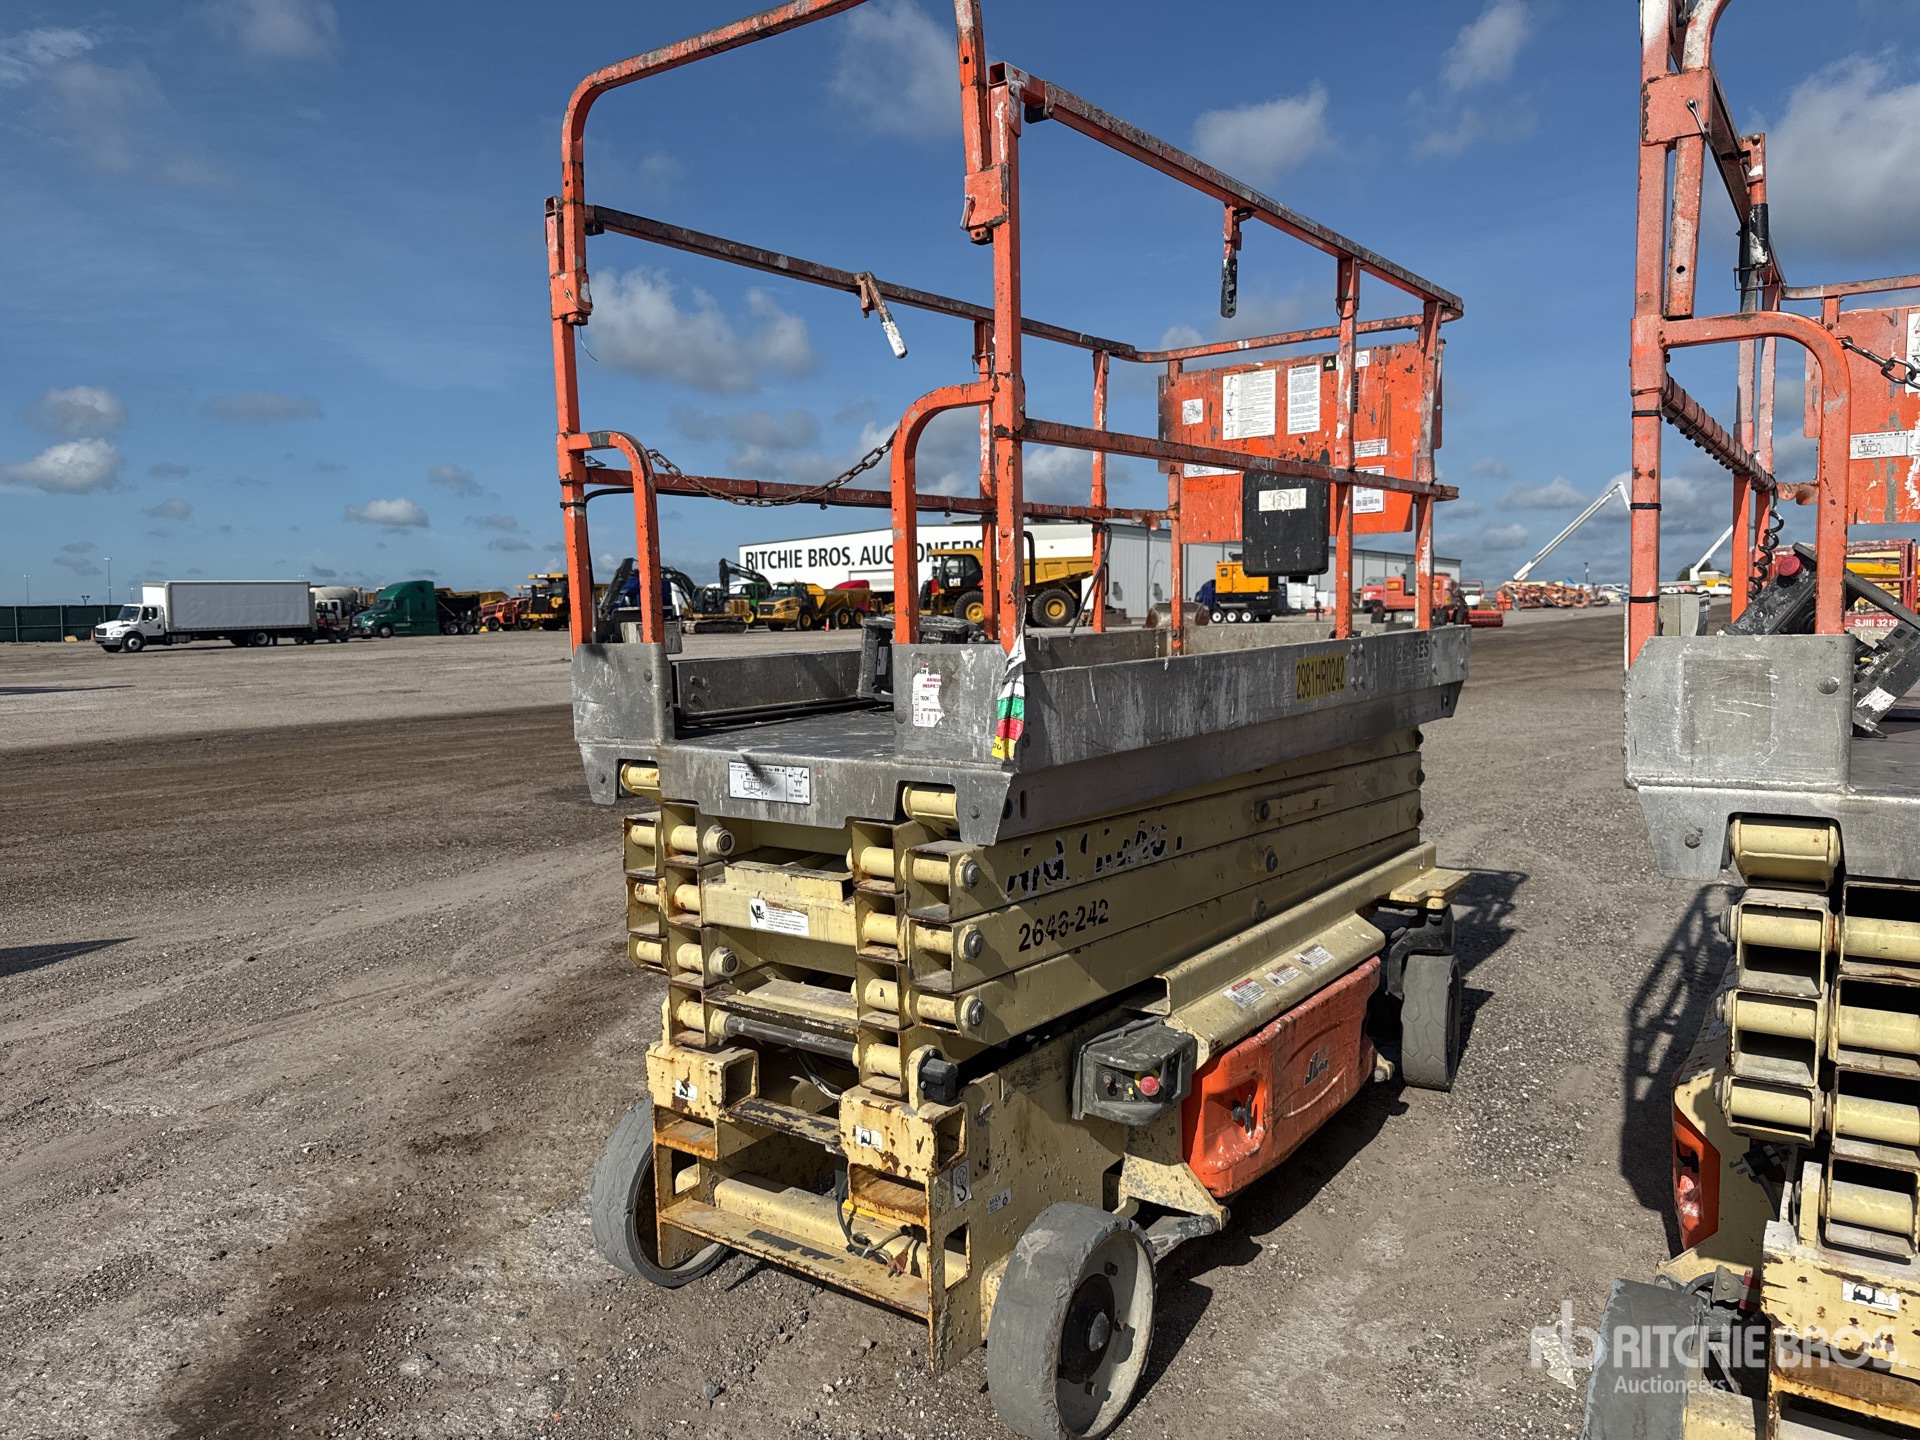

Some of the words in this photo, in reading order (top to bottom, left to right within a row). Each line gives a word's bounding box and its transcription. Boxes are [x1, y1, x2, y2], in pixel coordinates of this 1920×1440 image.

[745, 547, 803, 571] RITCHIE
[808, 547, 855, 568] BROS.
[948, 578, 961, 587] CAT
[1876, 619, 1898, 627] 3219
[1296, 655, 1345, 700] 2981HR0242
[1018, 898, 1109, 952] 2646-242
